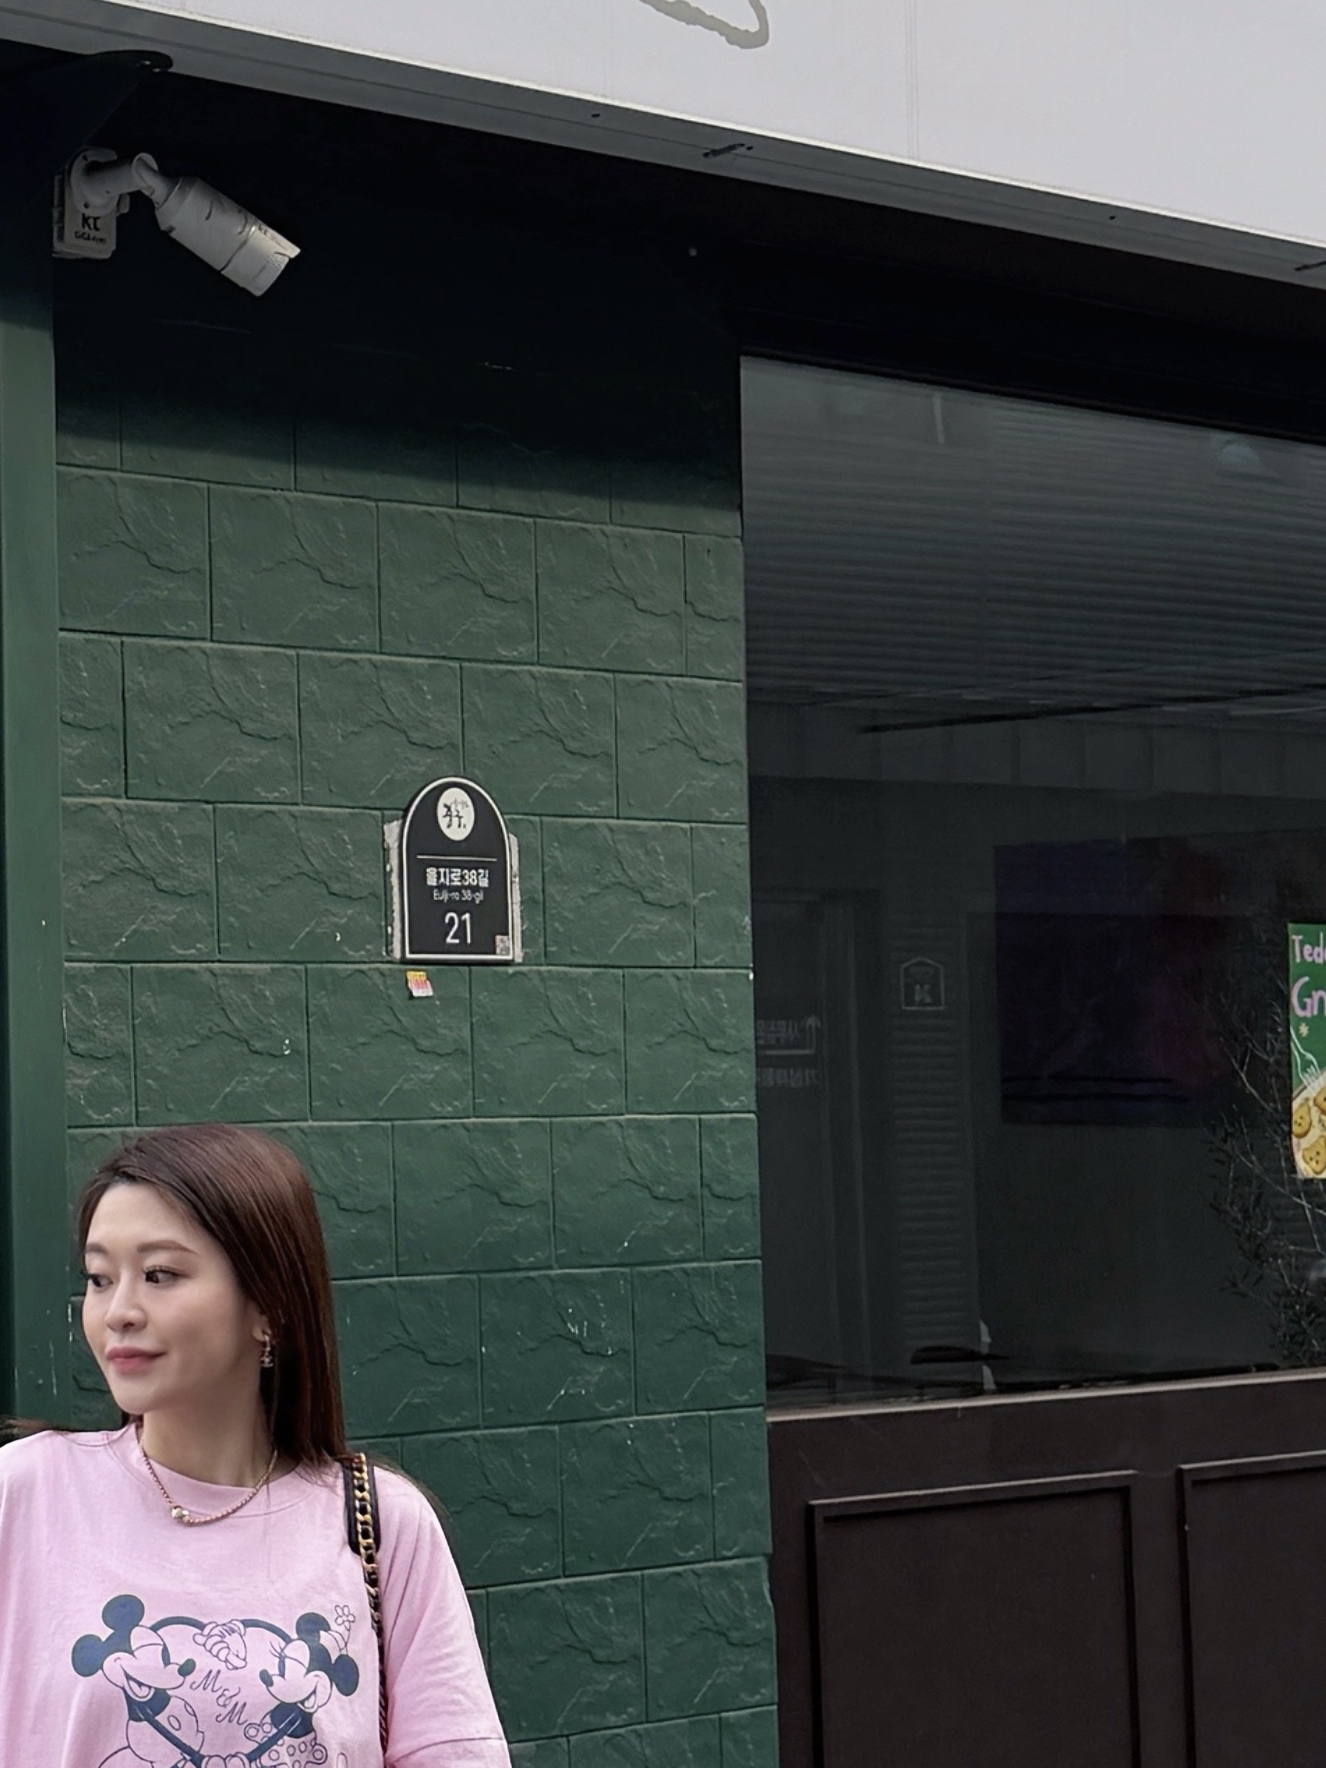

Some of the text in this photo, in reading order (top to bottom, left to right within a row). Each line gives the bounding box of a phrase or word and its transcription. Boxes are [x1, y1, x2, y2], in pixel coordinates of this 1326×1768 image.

[426, 866, 489, 888] 을지로38길
[461, 889, 484, 905] 38-gil
[444, 911, 472, 945] 21
[1291, 931, 1326, 965] Ted
[189, 1669, 223, 1693] M
[215, 1701, 249, 1726] M
